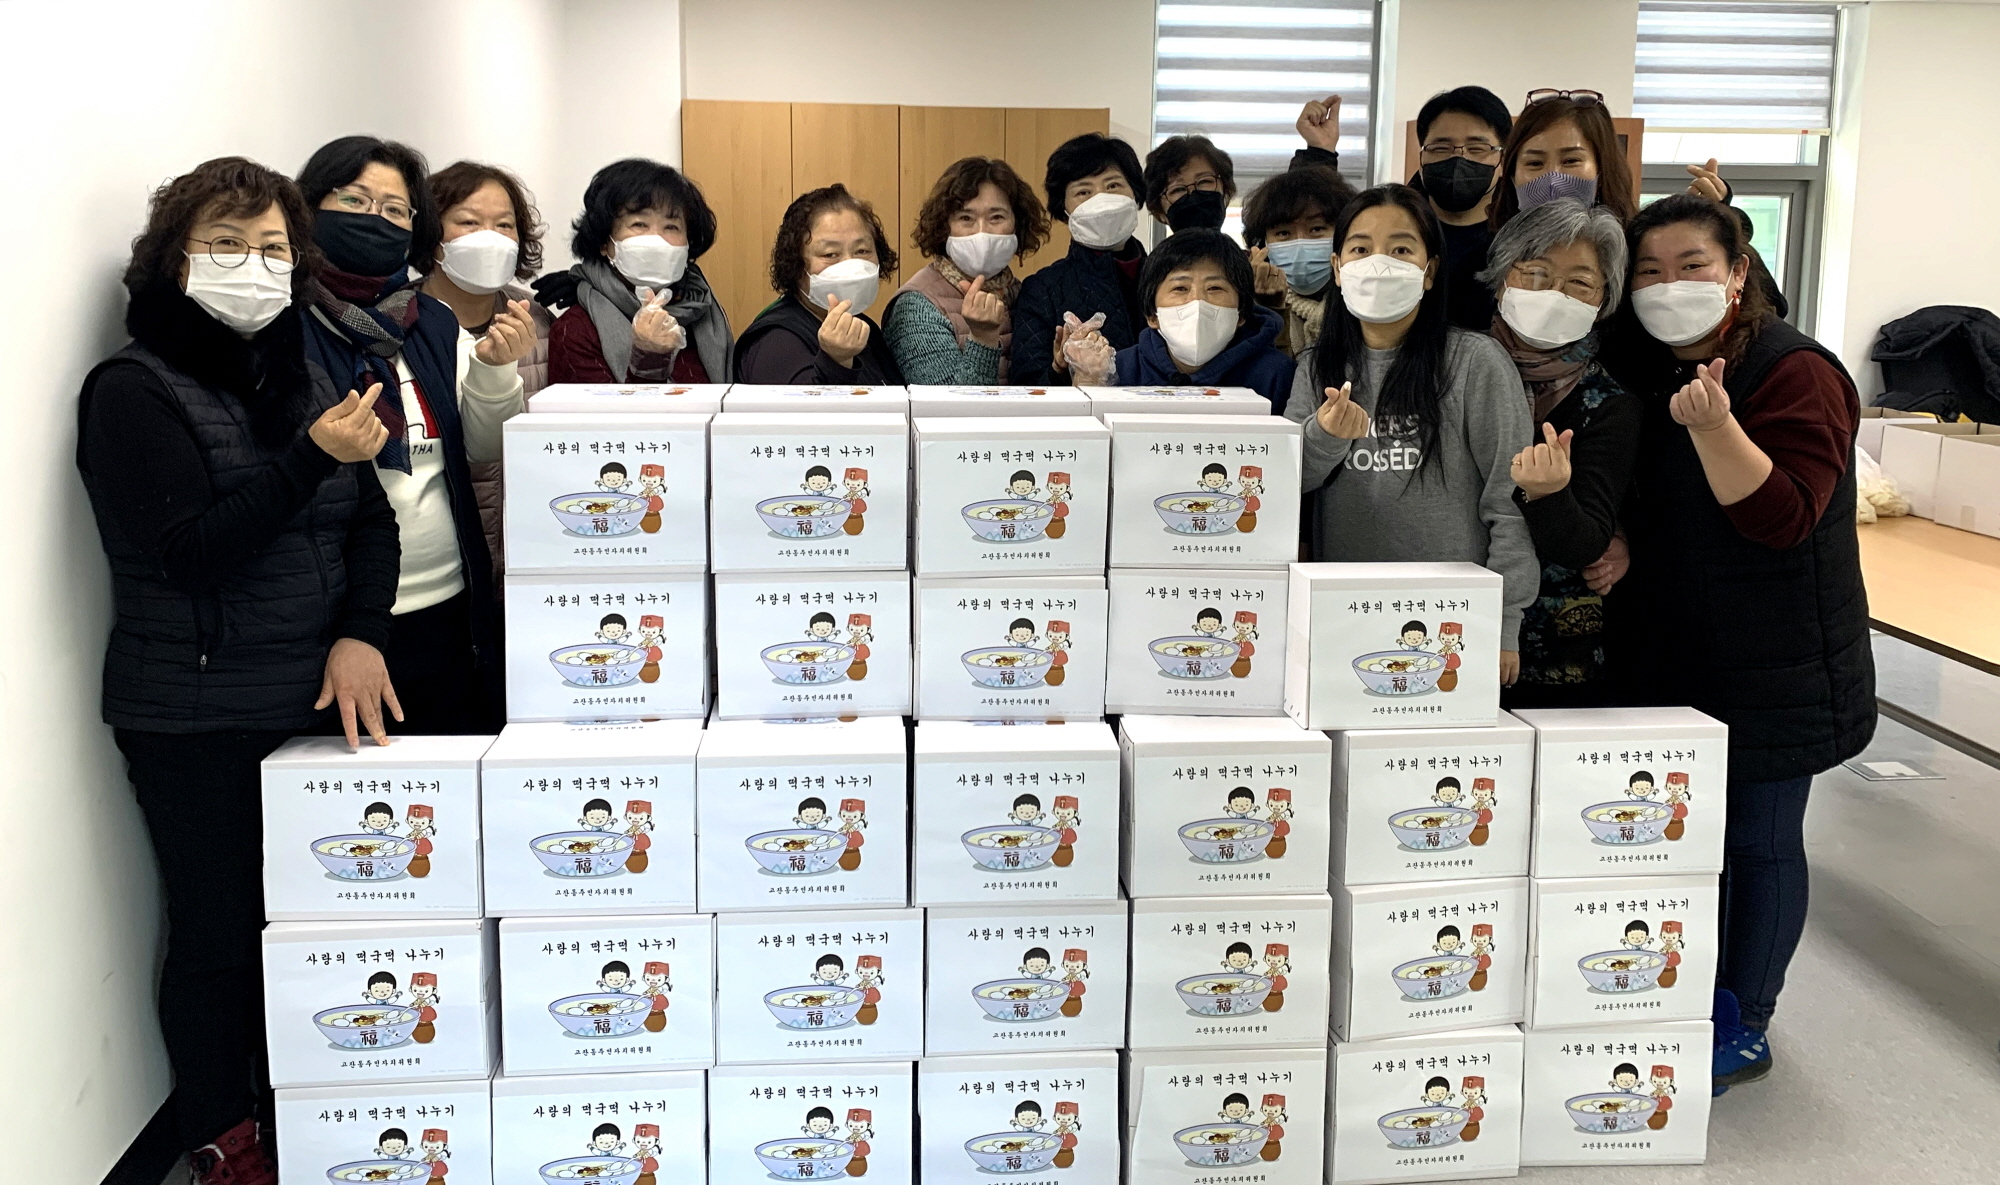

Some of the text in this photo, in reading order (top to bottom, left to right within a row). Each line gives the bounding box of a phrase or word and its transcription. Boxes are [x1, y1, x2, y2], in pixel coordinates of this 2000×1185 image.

[411, 444, 434, 455] THA
[542, 441, 671, 454] 사랑의 떡국떡 나누기
[750, 444, 874, 458] 사랑의 떡국떡 나누기
[1149, 442, 1269, 455] 사랑의 떡국떡 나누기
[956, 449, 1077, 463] 사랑의 떡국떡 나누기
[591, 517, 609, 533] 福
[796, 519, 813, 535] 福
[999, 523, 1016, 539] 福
[1191, 516, 1207, 531] 福
[543, 592, 670, 607] 사랑의 떡국떡 나누기
[755, 591, 878, 605] 사랑의 떡국떡 나누기
[1145, 586, 1264, 601] 사랑의 떡국떡 나누기
[956, 597, 1077, 610] 사랑의 떡국떡 나누기
[1347, 598, 1469, 613] 사랑의 떡국떡 나누기
[591, 668, 608, 684] 福
[800, 666, 817, 681] 福
[1185, 660, 1201, 676] 福
[999, 670, 1015, 685] 福
[1391, 676, 1408, 692] 福
[1384, 754, 1502, 771] 사랑의 떡국떡 나누기
[1576, 749, 1696, 764] 사랑의 떡국떡 나누기
[956, 771, 1085, 786] 사랑의 떡국떡 나누기
[1172, 764, 1298, 780] 사랑의 떡국떡 나누기
[303, 779, 440, 793] 사랑의 떡국떡 나누기
[522, 775, 659, 791] 사랑의 떡국떡 나누기
[739, 774, 872, 791] 사랑의 떡국떡 나누기
[1425, 831, 1441, 847] 福
[1618, 825, 1634, 841] 福
[1003, 851, 1020, 867] 福
[1217, 843, 1234, 859] 福
[355, 860, 374, 877] 福
[574, 857, 592, 874] 福
[788, 855, 806, 871] 福
[1386, 900, 1499, 923] 사랑의 떡국떡 나누기
[1574, 897, 1689, 914] 사랑의 떡국떡 나누기
[967, 925, 1094, 940] 사랑의 떡국떡 나누기
[1171, 920, 1296, 935] 사랑의 떡국떡 나누기
[541, 937, 676, 955] 사랑의 떡국떡 나누기
[757, 931, 889, 947] 사랑의 떡국떡 나누기
[305, 947, 444, 965] 사랑의 떡국떡 나누기
[1427, 980, 1442, 996] 福
[1613, 973, 1629, 989] 福
[1012, 1002, 1029, 1018] 福
[1215, 997, 1232, 1014] 福
[593, 1018, 611, 1034] 福
[806, 1010, 824, 1026] 福
[359, 1029, 378, 1046] 福
[1560, 1042, 1680, 1055] 사랑의 떡국떡 나누기
[1372, 1052, 1491, 1072] 사랑의 떡국떡 나누기
[958, 1078, 1085, 1094] 사랑의 떡국떡 나누기
[1167, 1071, 1292, 1087] 사랑의 떡국떡 나누기
[749, 1085, 878, 1099] 사랑의 떡국떡 나누기
[318, 1104, 455, 1122] 사랑의 떡국떡 나누기
[533, 1099, 666, 1117] 사랑의 떡국떡 나누기
[1602, 1115, 1618, 1131] 福
[1415, 1129, 1431, 1146] 福
[1004, 1154, 1021, 1170] 福
[1212, 1147, 1229, 1163] 福
[797, 1161, 814, 1176] 福
